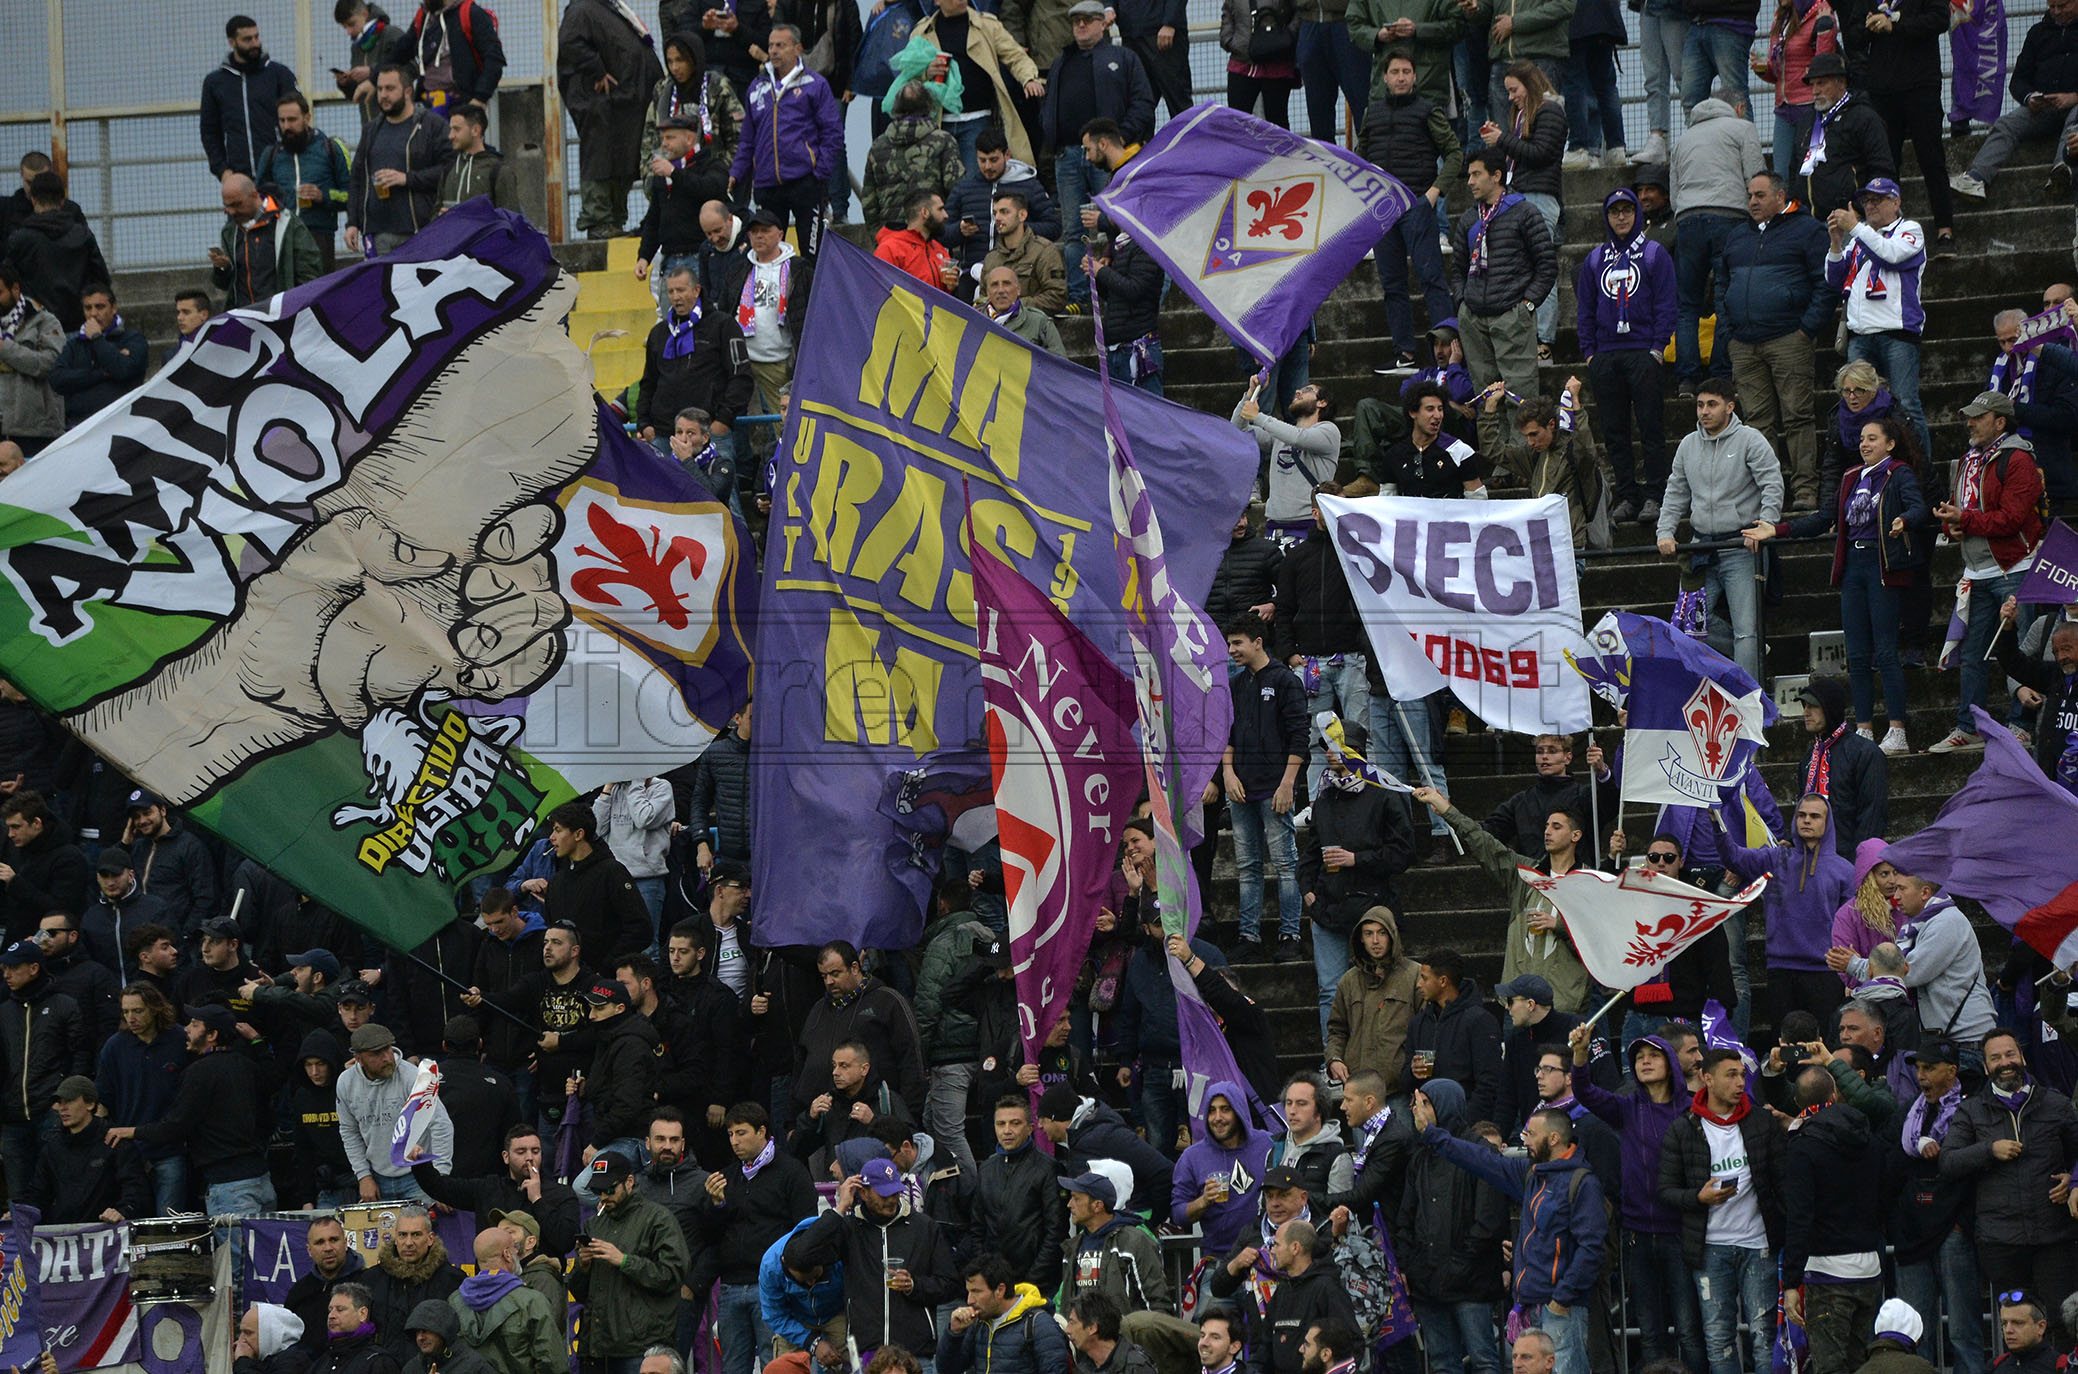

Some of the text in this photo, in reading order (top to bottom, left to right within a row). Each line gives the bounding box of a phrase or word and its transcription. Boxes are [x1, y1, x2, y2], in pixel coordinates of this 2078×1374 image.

[113, 253, 517, 617] VIOLA
[858, 284, 1032, 482] MA
[1336, 512, 1560, 616] SIECI
[398, 716, 521, 874] ULTRAS
[1009, 633, 1112, 844] Never
[1671, 771, 1714, 798] AVANTI
[248, 1229, 298, 1283] LA
